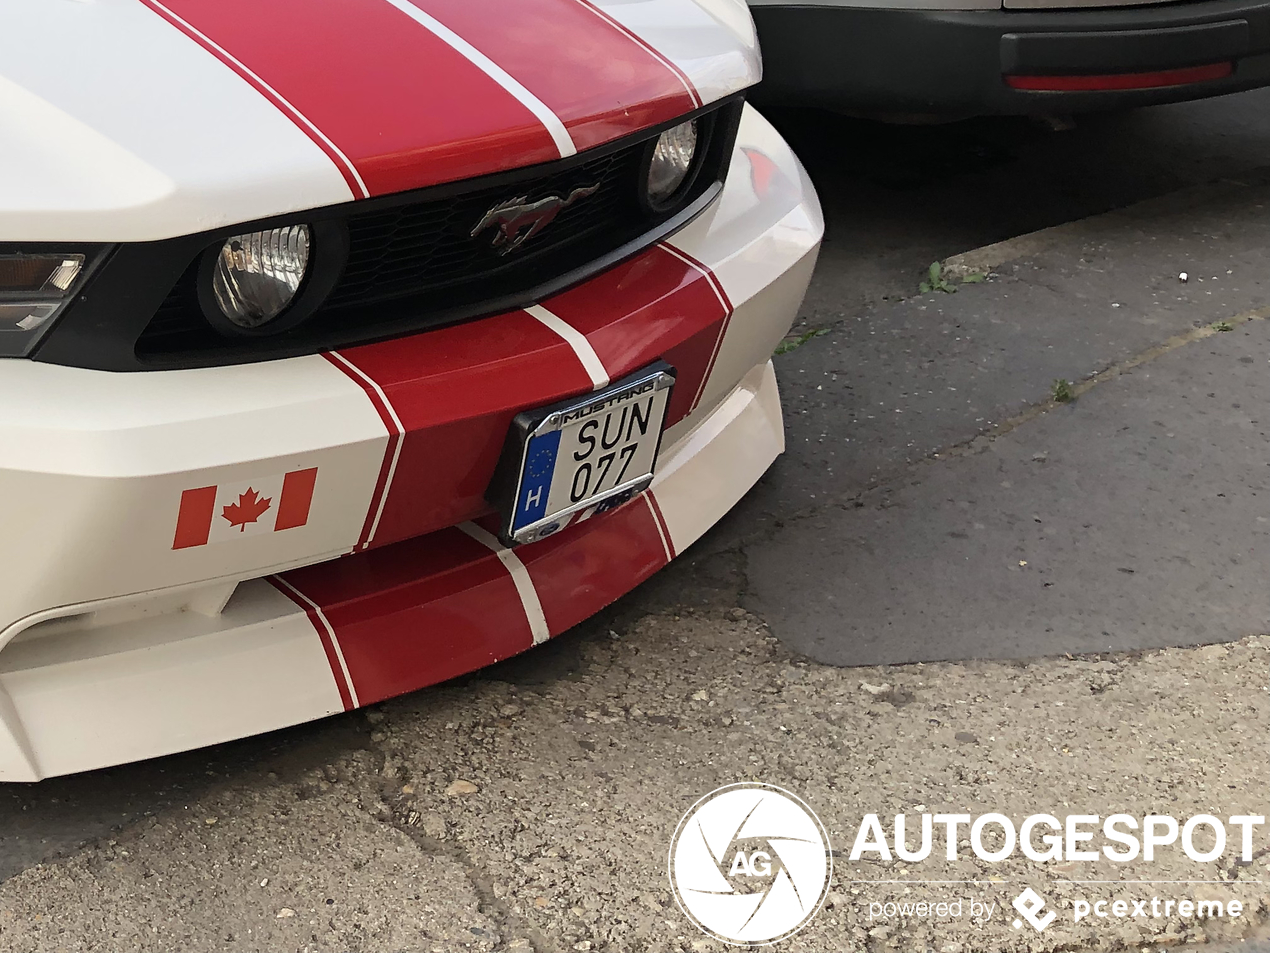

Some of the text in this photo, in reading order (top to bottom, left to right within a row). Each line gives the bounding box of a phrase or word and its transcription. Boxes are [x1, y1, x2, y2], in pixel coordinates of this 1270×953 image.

[563, 381, 655, 424] MUSTANG
[574, 396, 654, 461] SUN
[524, 485, 543, 512] H
[570, 443, 638, 503] 077
